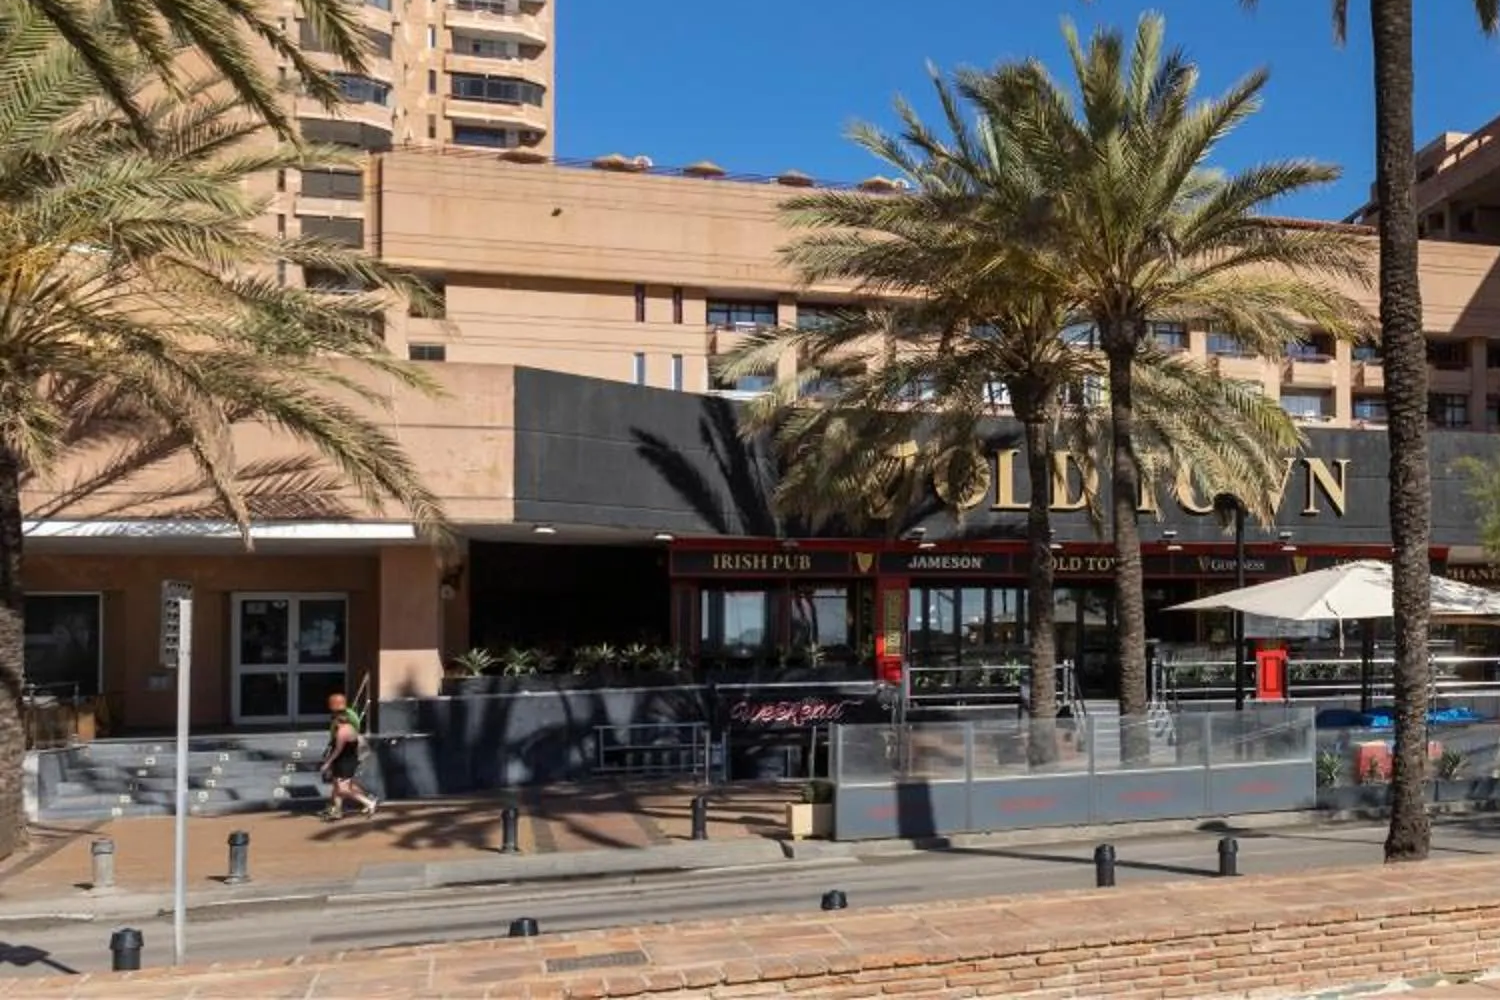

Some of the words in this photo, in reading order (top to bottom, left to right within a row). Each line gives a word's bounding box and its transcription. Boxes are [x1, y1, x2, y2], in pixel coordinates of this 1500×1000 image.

[712, 552, 767, 571] IRISH
[773, 553, 812, 571] PUB
[908, 555, 983, 570] JAMESON
